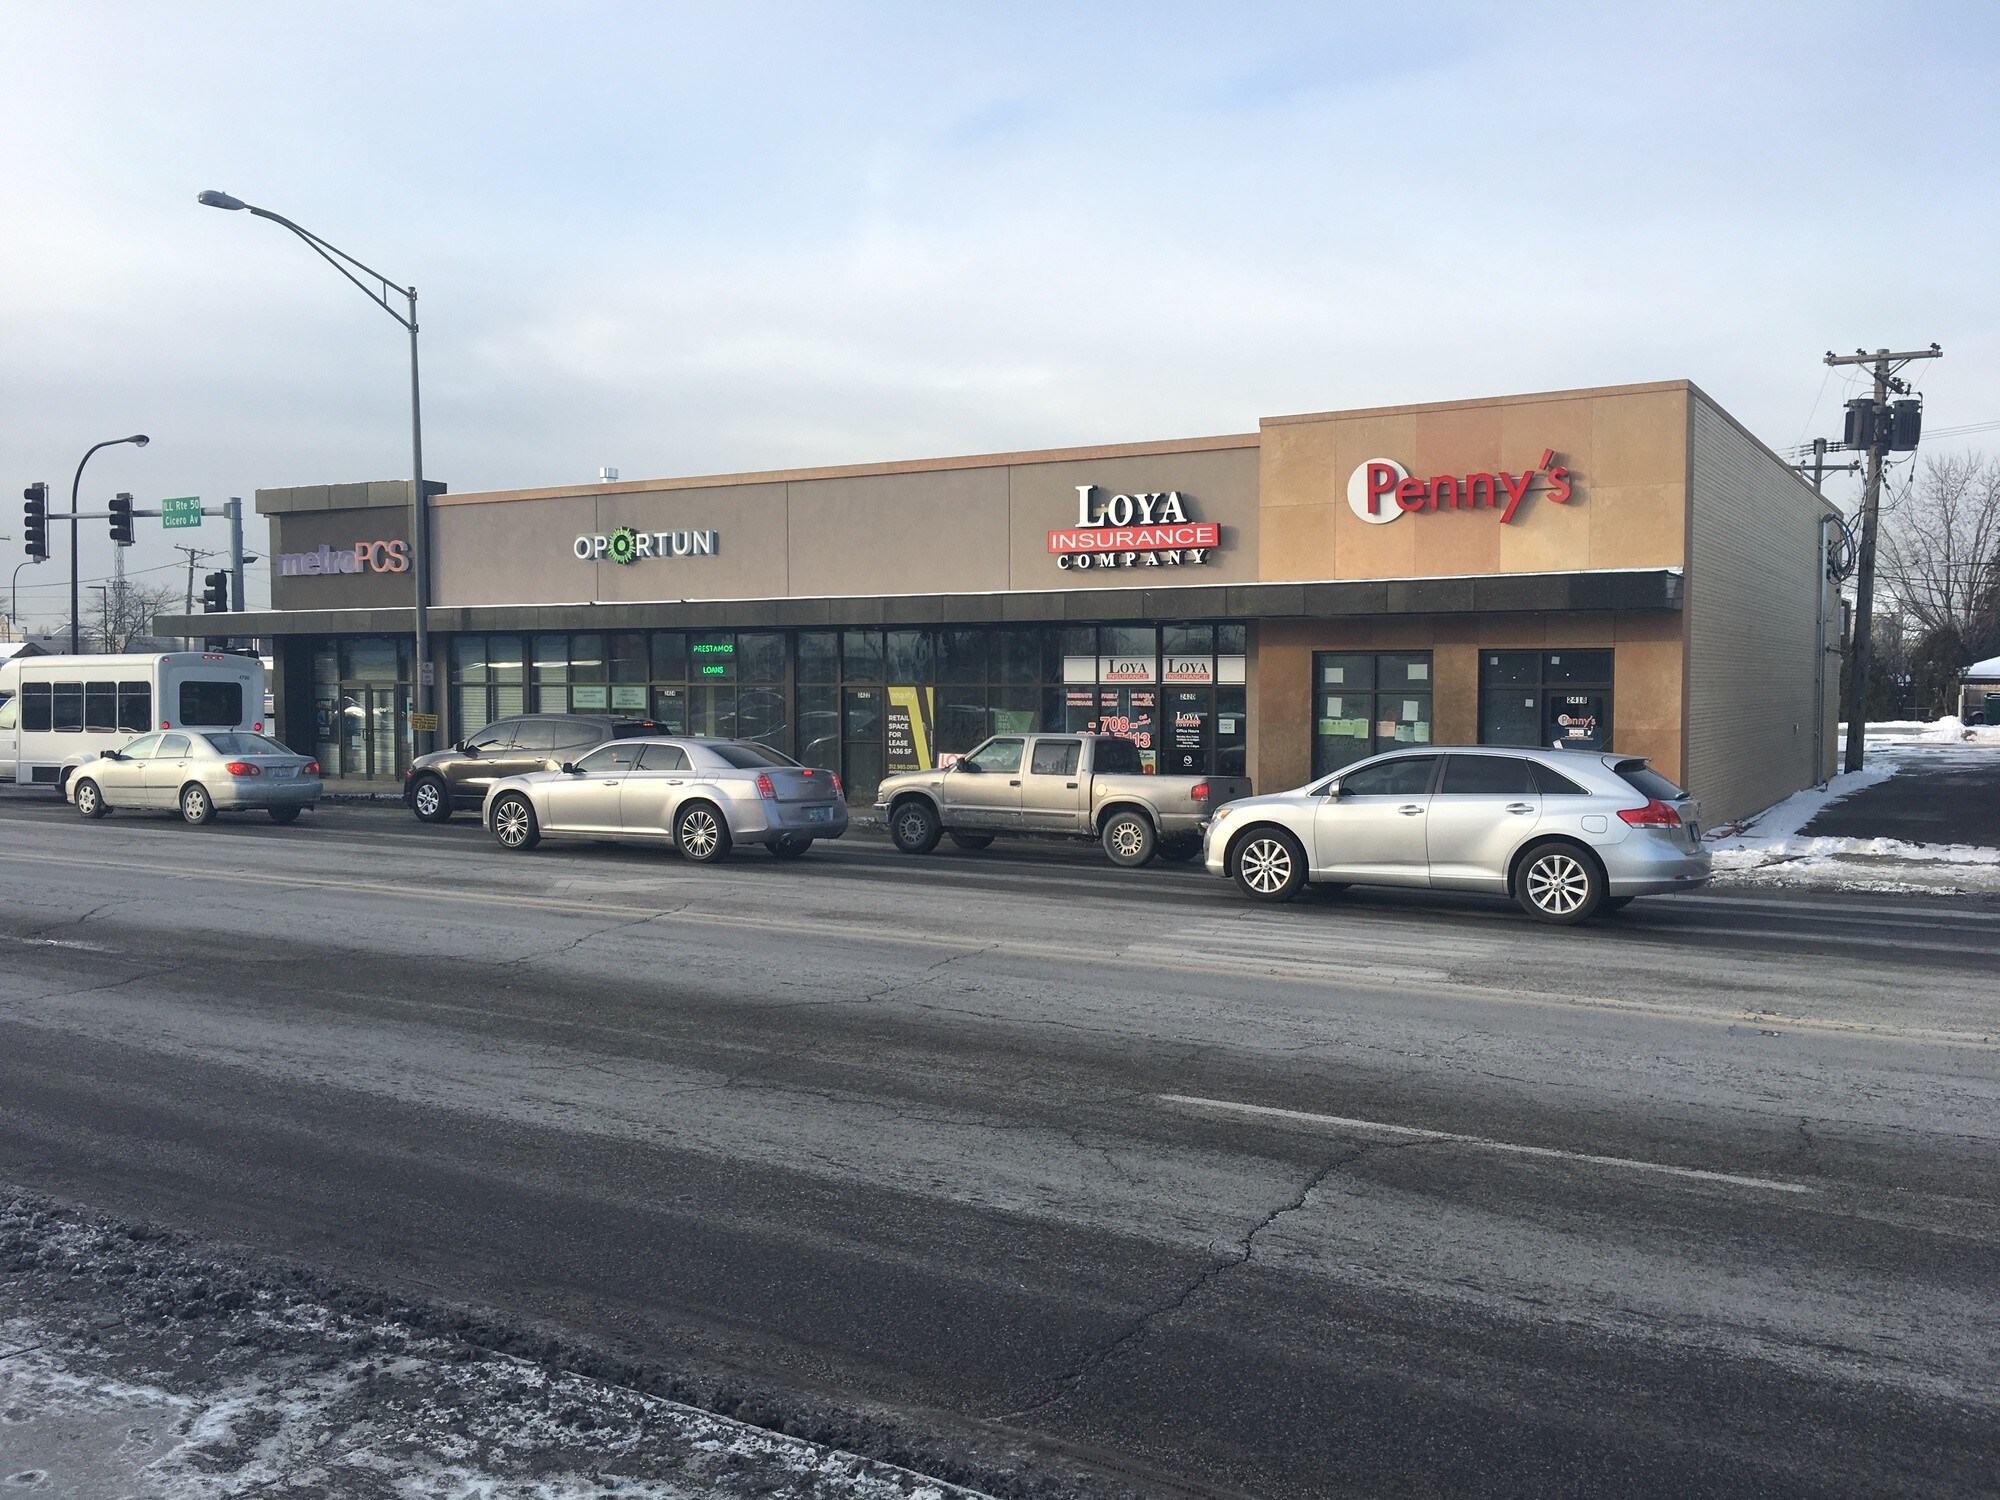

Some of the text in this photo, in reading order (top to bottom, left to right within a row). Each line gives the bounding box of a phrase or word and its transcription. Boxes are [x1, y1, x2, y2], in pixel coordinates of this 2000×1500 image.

[1366, 447, 1572, 525] Penny's
[175, 500, 188, 511] Rte
[190, 499, 200, 510] 50
[1074, 484, 1188, 529] LOYA
[164, 514, 199, 526] Cicero Av
[573, 526, 716, 565] OPORTUN
[1051, 527, 1214, 550] INSURANCE
[276, 539, 410, 577] metroPCS
[1056, 548, 1206, 571] COMPANY
[693, 644, 734, 653] PRESTAMOS
[702, 666, 724, 674] LOANS
[1108, 659, 1147, 674] LOYA
[1167, 658, 1208, 674] LOYA
[888, 714, 910, 722] RETAIL
[1176, 711, 1200, 720] LOYA
[1560, 715, 1597, 728] Penny's
